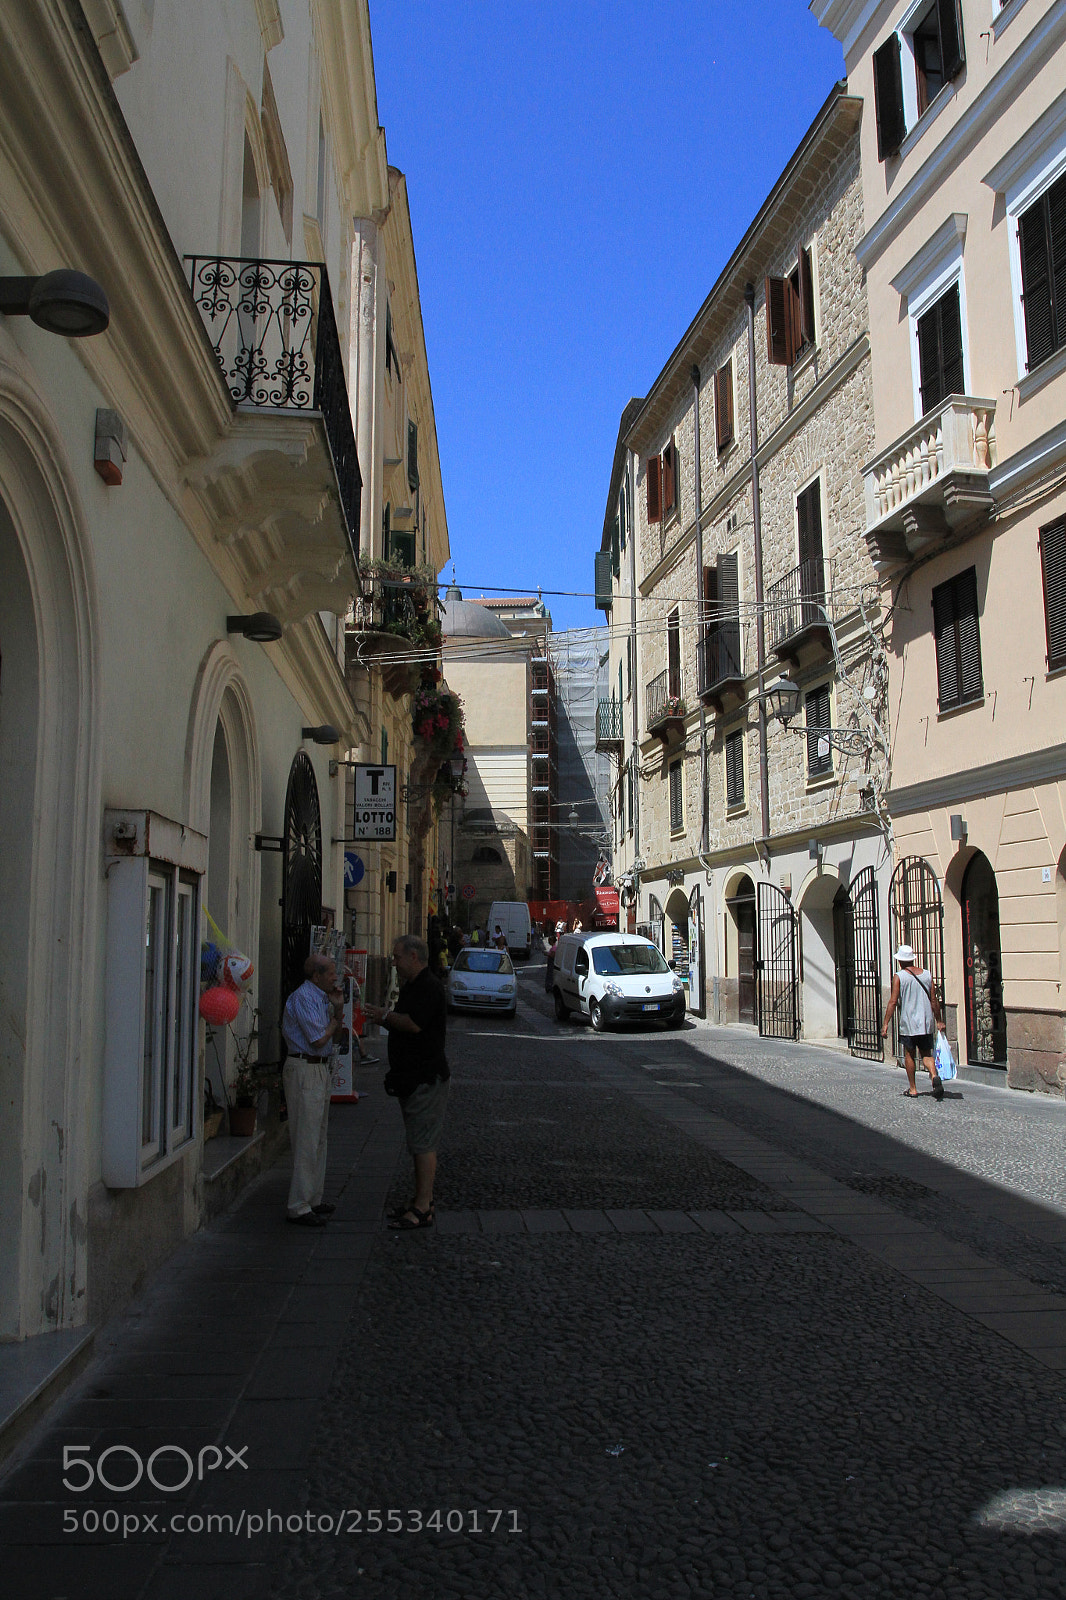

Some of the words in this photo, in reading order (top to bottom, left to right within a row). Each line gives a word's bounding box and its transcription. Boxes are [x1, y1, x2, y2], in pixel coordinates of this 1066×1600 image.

[366, 770, 384, 795] T
[356, 811, 393, 823] LOTTO
[374, 826, 391, 835] 188
